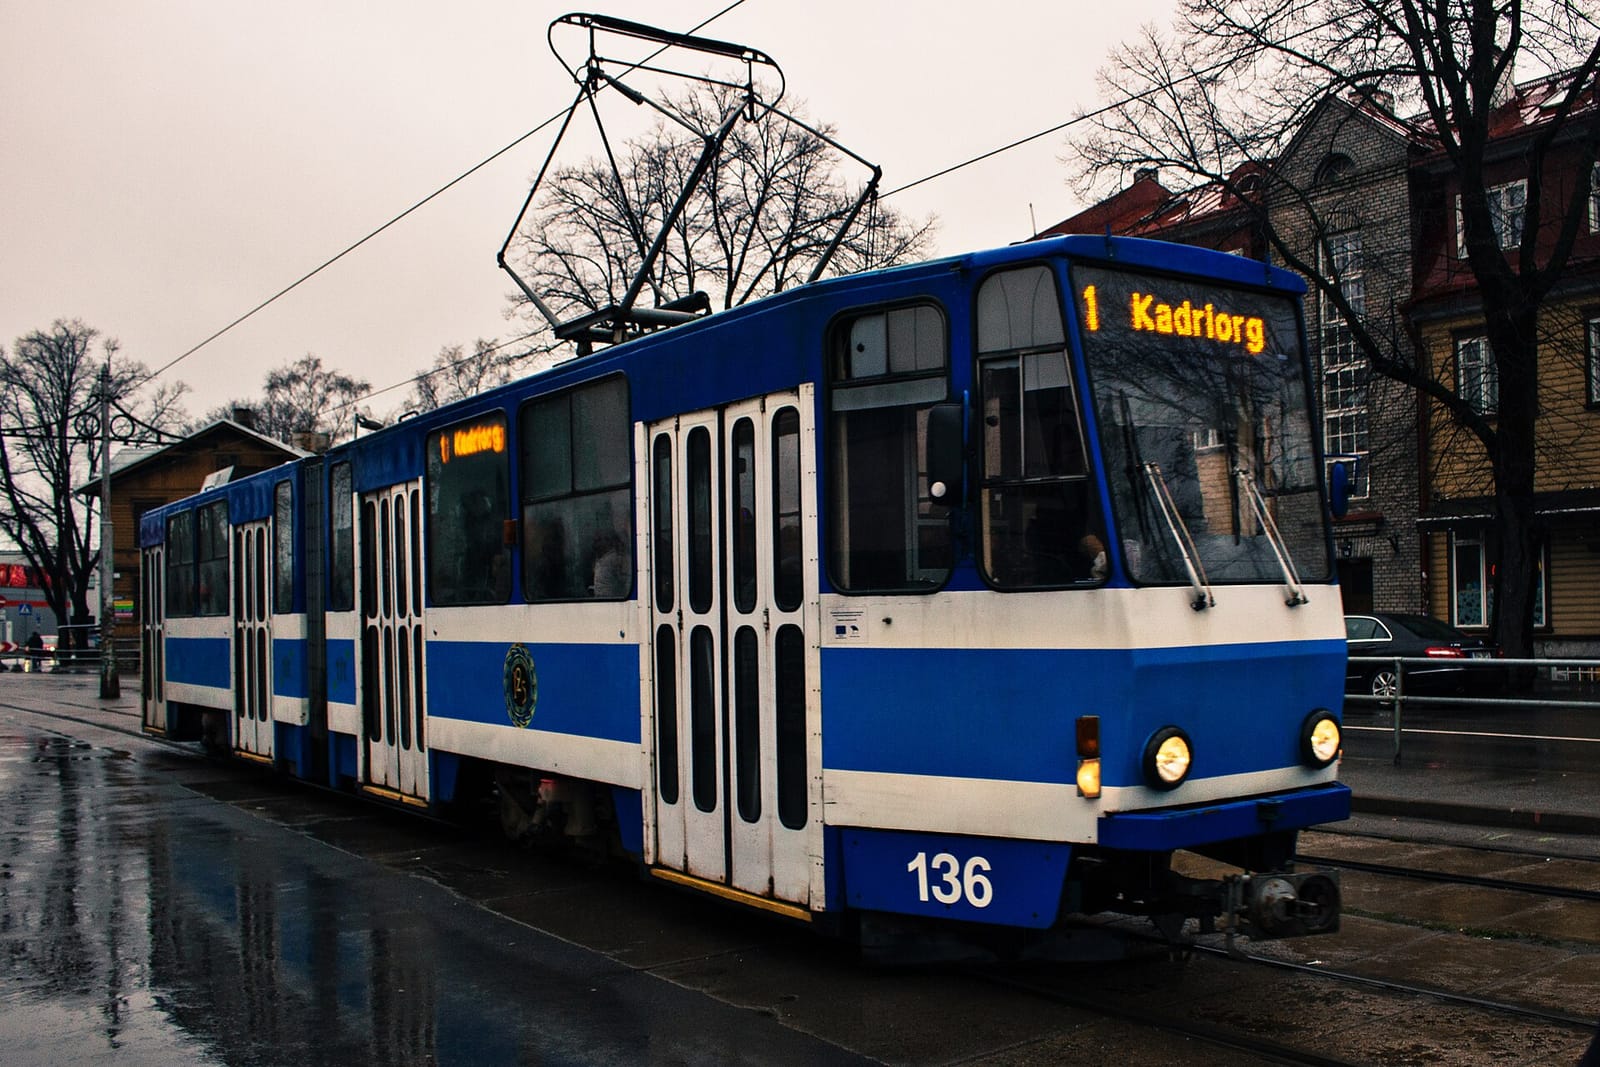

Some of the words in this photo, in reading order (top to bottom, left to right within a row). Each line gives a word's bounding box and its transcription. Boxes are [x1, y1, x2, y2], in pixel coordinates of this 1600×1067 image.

[1083, 285, 1099, 331] 1
[1131, 292, 1265, 354] Kadriorg
[907, 851, 993, 908] 136
